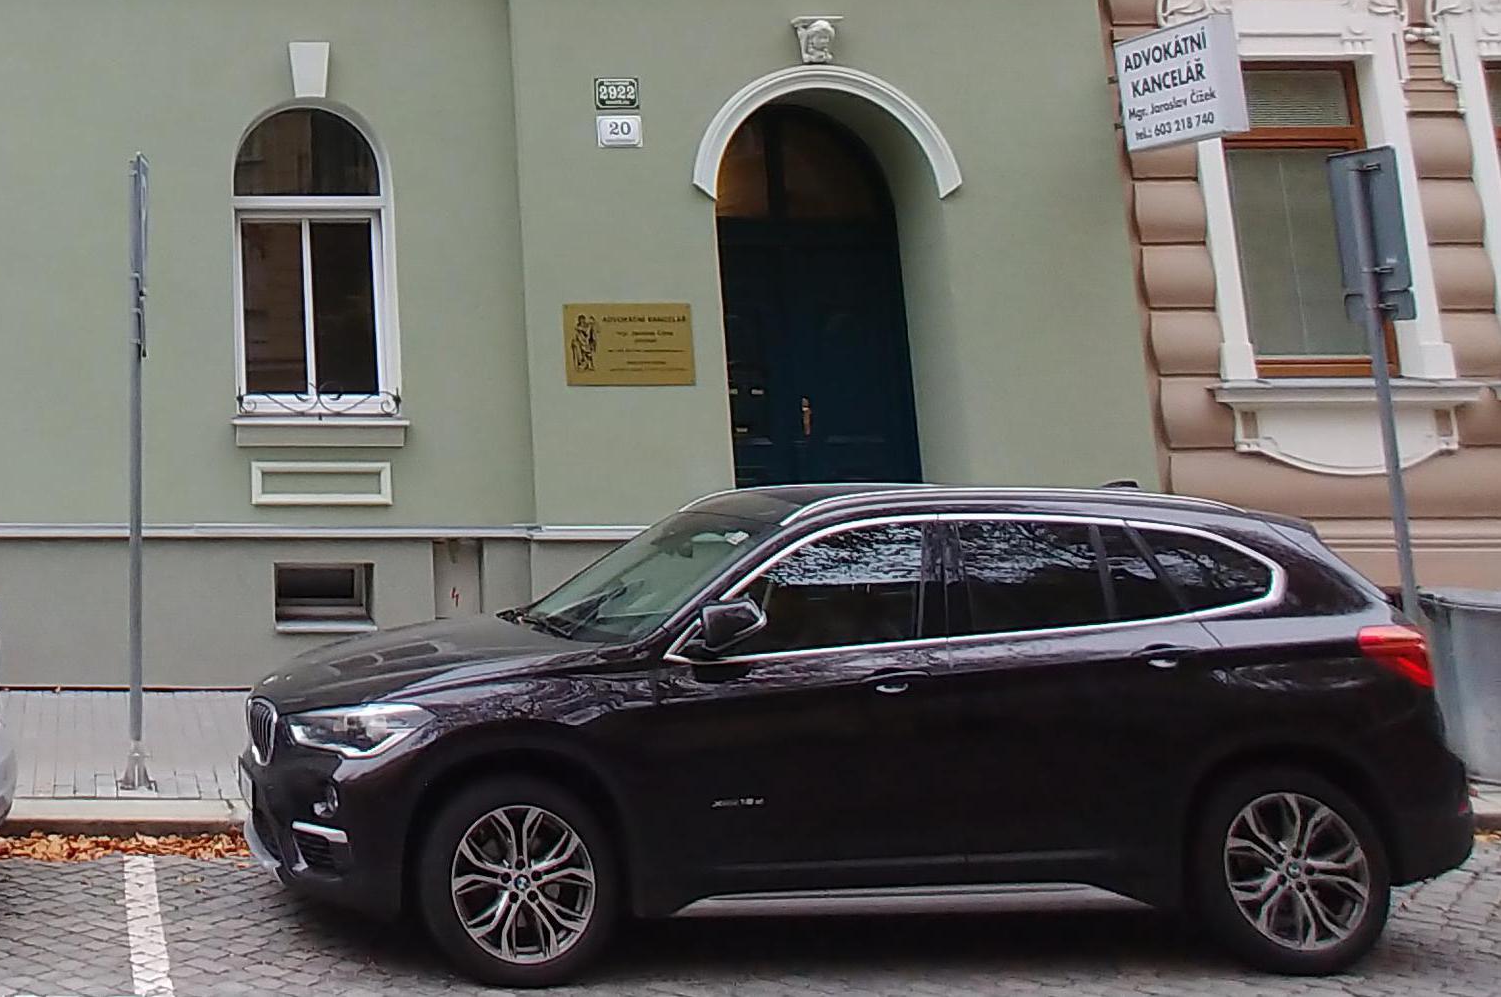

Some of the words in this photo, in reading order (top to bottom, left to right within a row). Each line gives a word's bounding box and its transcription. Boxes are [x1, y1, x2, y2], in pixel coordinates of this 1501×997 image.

[1124, 27, 1207, 73] ADVOKÁTNÍ
[1131, 58, 1206, 98] KANCELÁŘ
[599, 85, 636, 100] 2922
[1128, 106, 1148, 122] Mgr.
[1150, 96, 1188, 116] Jaroslav
[609, 121, 632, 136] 20
[1154, 120, 1173, 137] 603
[1174, 116, 1193, 132] 218
[1196, 111, 1215, 128] 740
